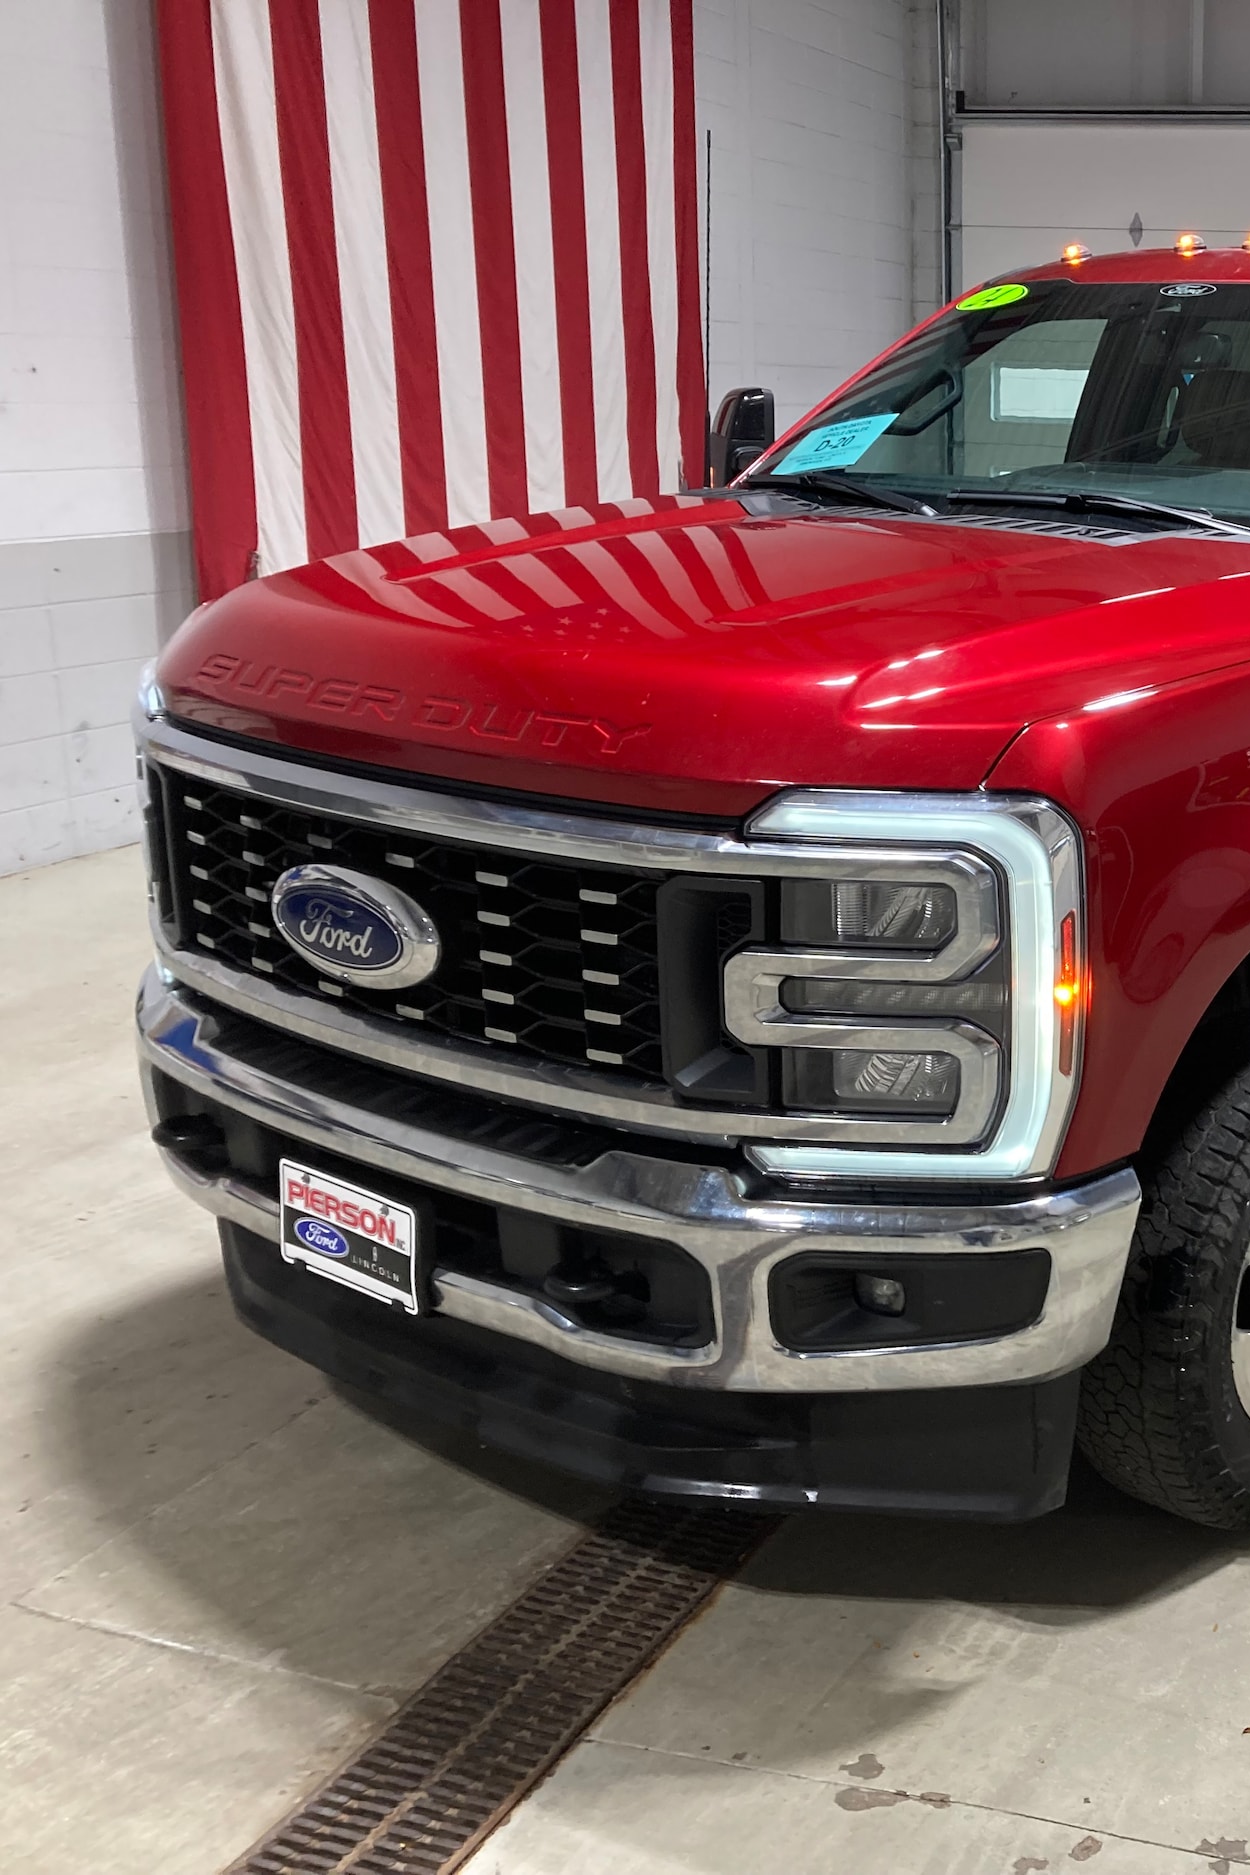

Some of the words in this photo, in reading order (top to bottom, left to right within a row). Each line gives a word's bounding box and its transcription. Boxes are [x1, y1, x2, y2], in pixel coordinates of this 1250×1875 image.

[1167, 284, 1209, 295] Ford
[814, 435, 856, 452] D-20
[196, 652, 401, 722] SUPER
[409, 696, 653, 755] DUTY
[300, 898, 374, 958] Ford
[287, 1178, 397, 1245] PIERSON
[304, 1222, 339, 1251] Ford
[351, 1255, 400, 1283] LINCOLN
